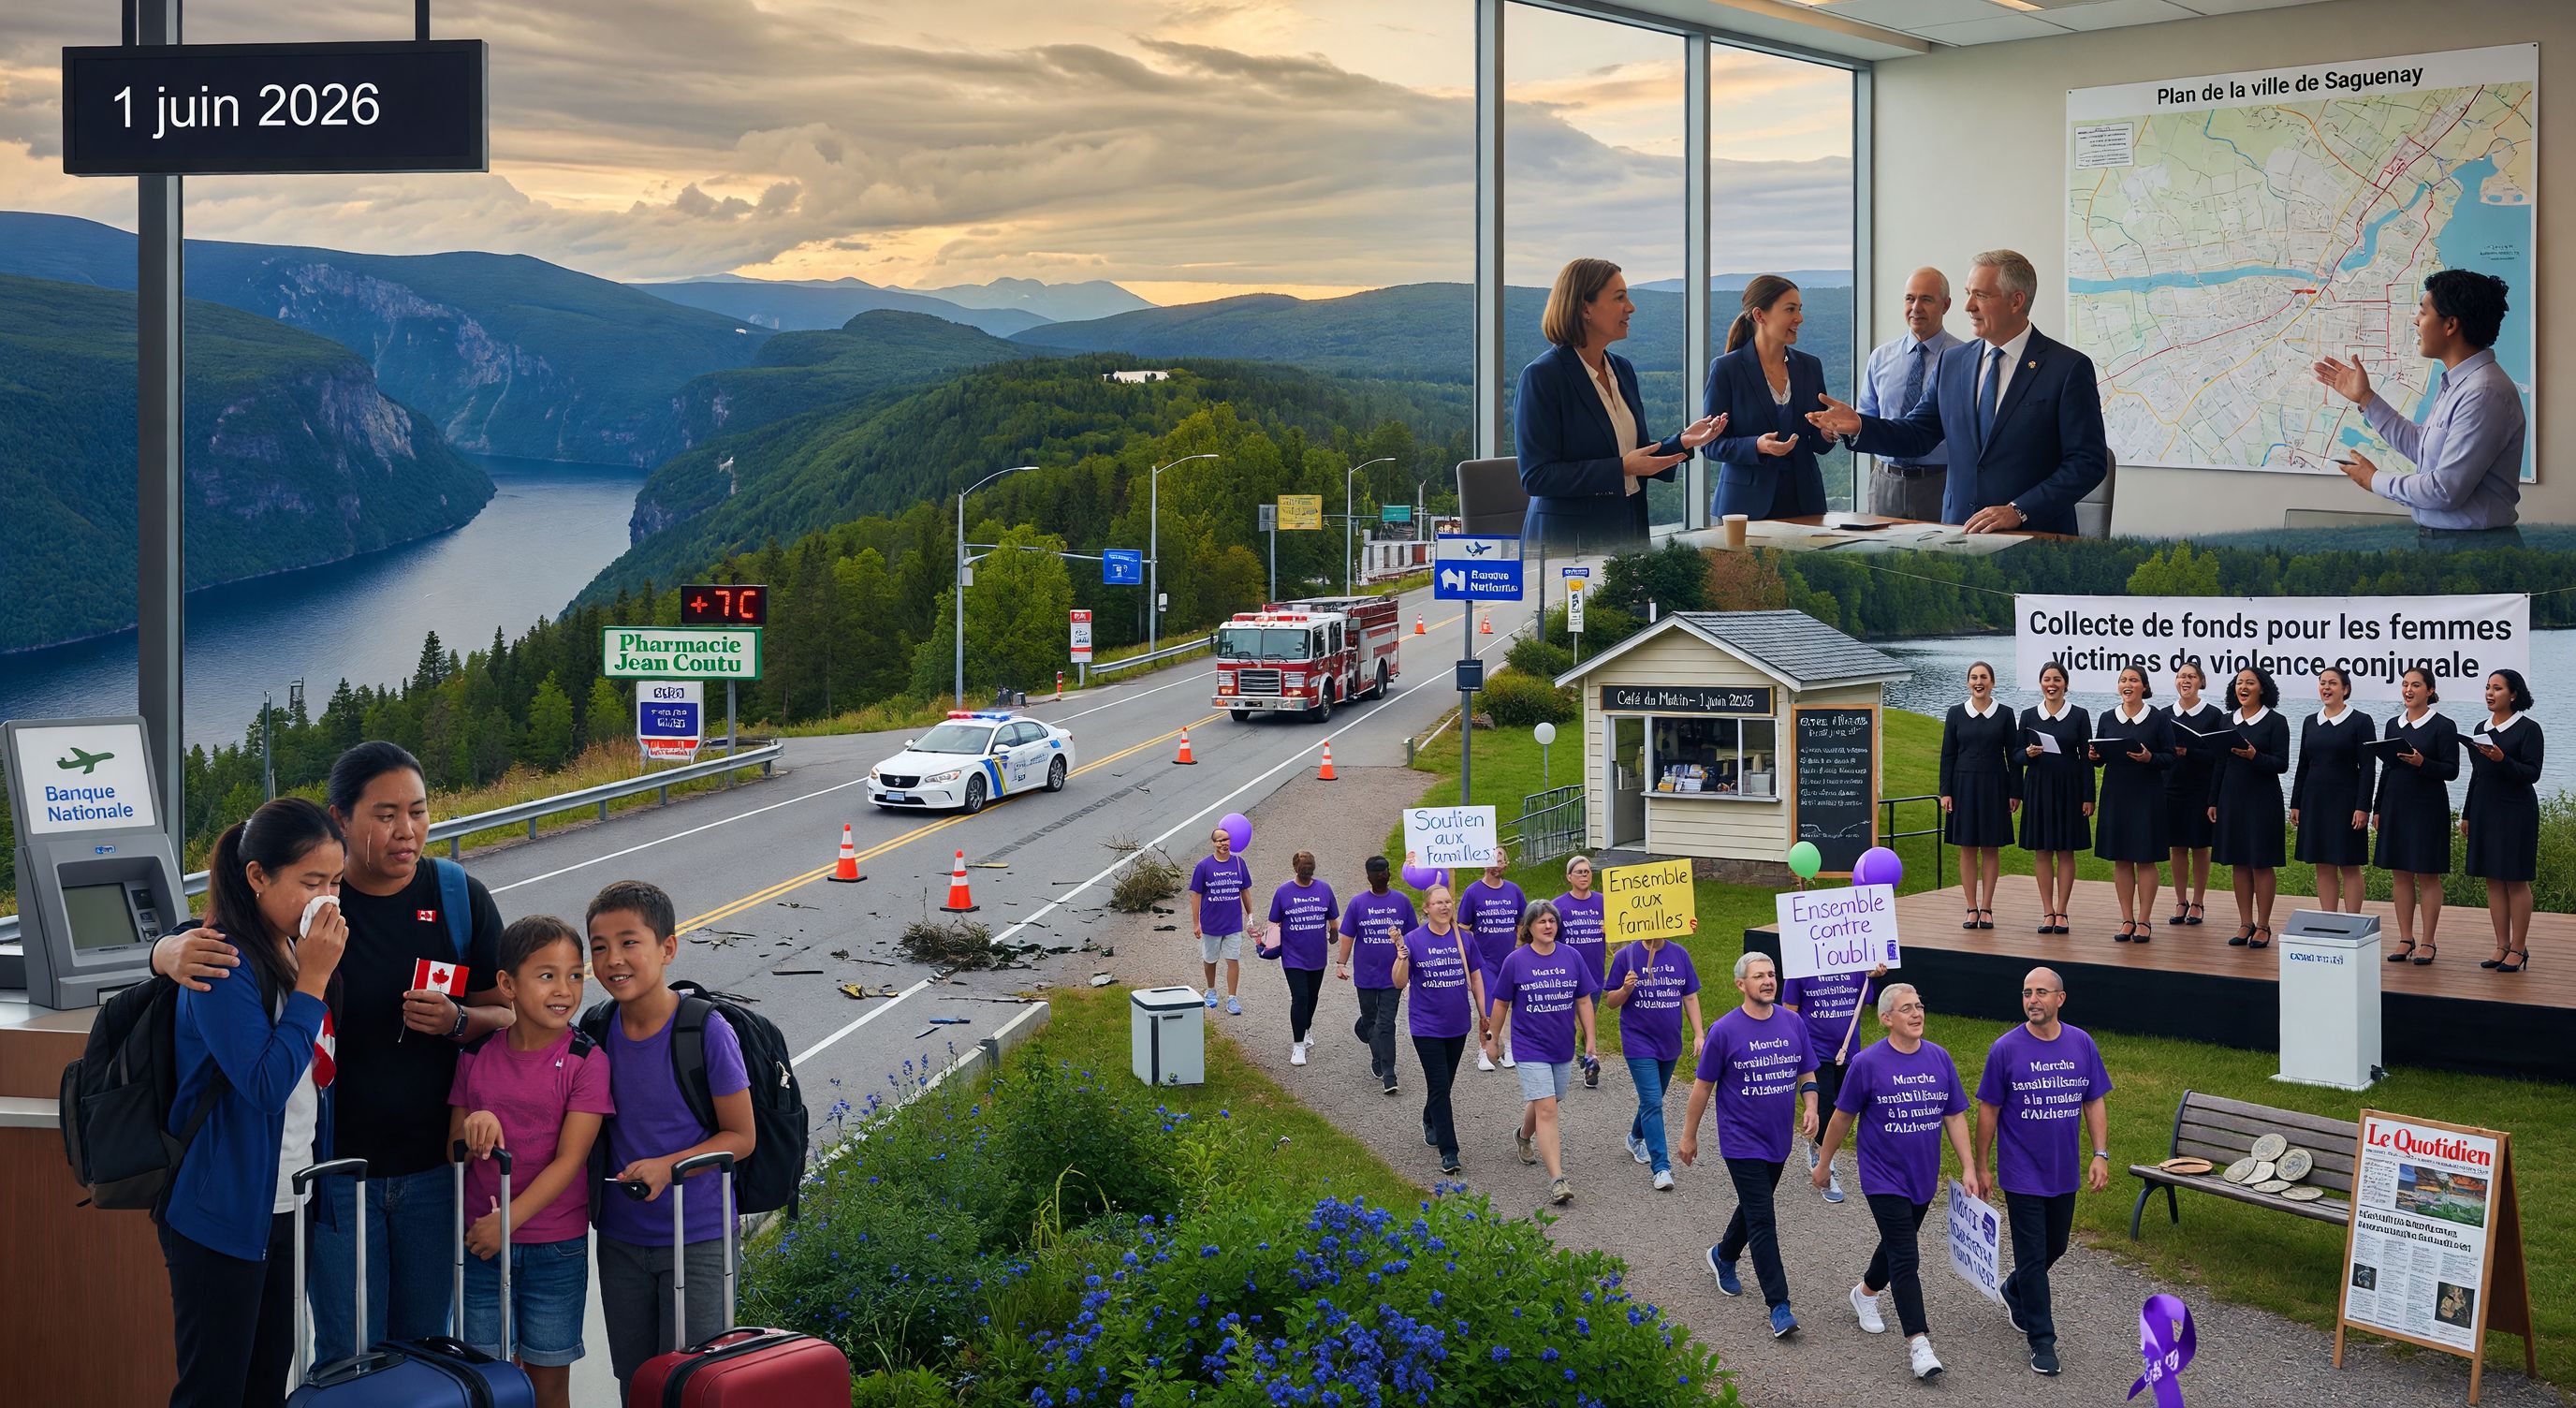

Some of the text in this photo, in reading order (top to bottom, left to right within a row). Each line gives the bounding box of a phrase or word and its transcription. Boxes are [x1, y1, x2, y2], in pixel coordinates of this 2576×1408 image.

[2158, 67, 2423, 105] Plan de la ville de Saguenay
[113, 82, 381, 139] 1 juin 2026
[2029, 610, 2512, 645] Collecte de fonds pour les femmes
[619, 634, 741, 653] Pharmacie
[614, 653, 741, 672] Jean Coutu
[2052, 645, 2161, 672] victimes
[2210, 649, 2325, 676] violence
[45, 785, 115, 803] Banque
[48, 802, 134, 822] Nationale
[1414, 810, 1485, 831] Soutien
[1435, 832, 1464, 844] aux
[1609, 867, 1688, 892] Ensemble
[1631, 893, 1662, 908] aux
[1793, 887, 1885, 922] Ensemble
[1617, 908, 1683, 935] familles
[1809, 917, 1873, 941] contre
[1814, 937, 1876, 969] l'oubli
[2367, 1123, 2392, 1148] Le
[2393, 1128, 2491, 1166] Quotidien
